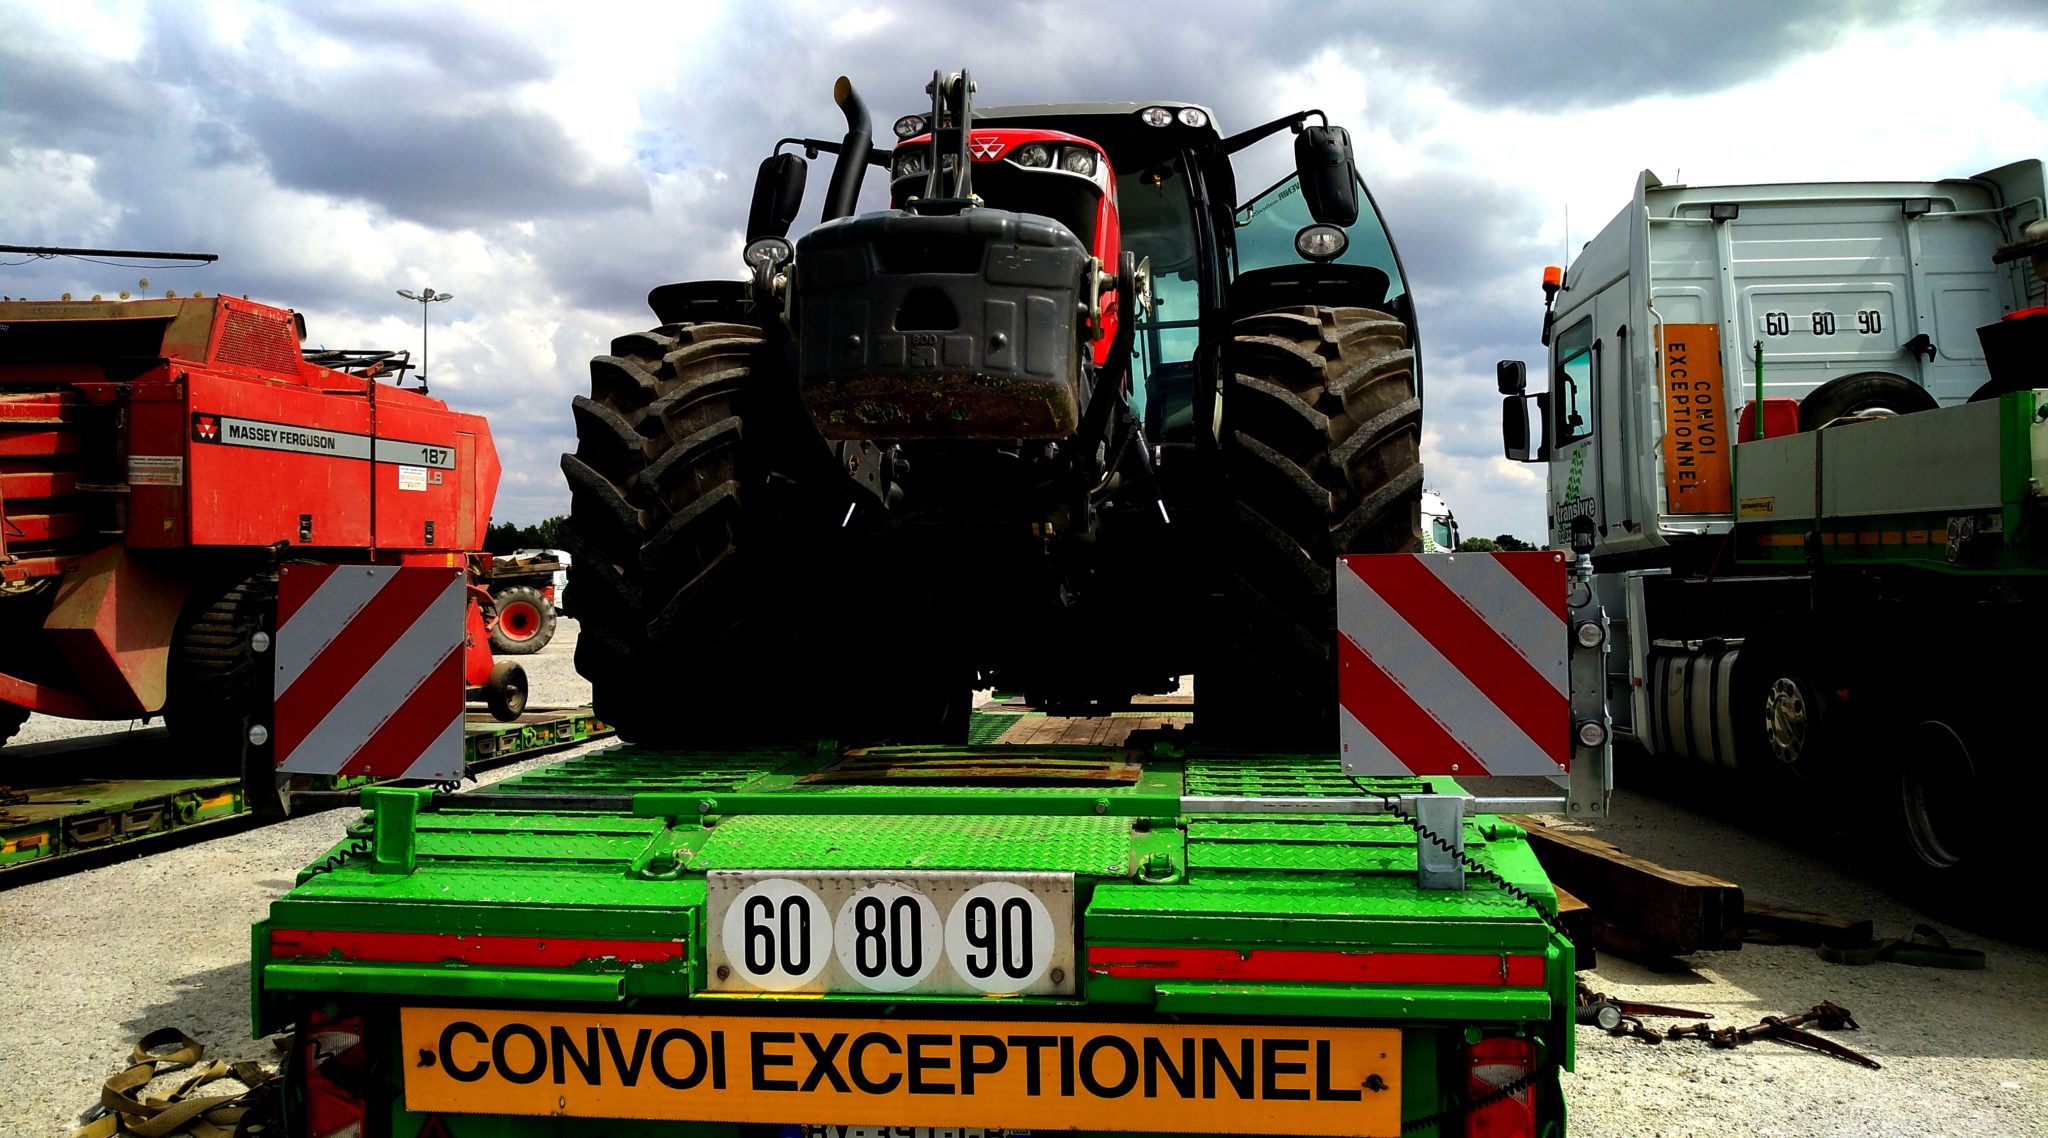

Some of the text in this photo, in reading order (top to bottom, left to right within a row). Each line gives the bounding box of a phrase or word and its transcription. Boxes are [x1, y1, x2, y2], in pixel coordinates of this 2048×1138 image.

[1766, 311, 1881, 335] 60 80 90
[912, 334, 938, 344] 800
[1668, 343, 1696, 494] EXCEPTIONNEL
[1694, 381, 1716, 454] CONVOI
[229, 424, 336, 450] MASSEY FERGUSON
[421, 448, 448, 465] 187
[427, 471, 443, 485] LB
[744, 895, 1034, 979] 60 80 90
[438, 1021, 1362, 1103] CONVOI EXCEPTIONNEL
